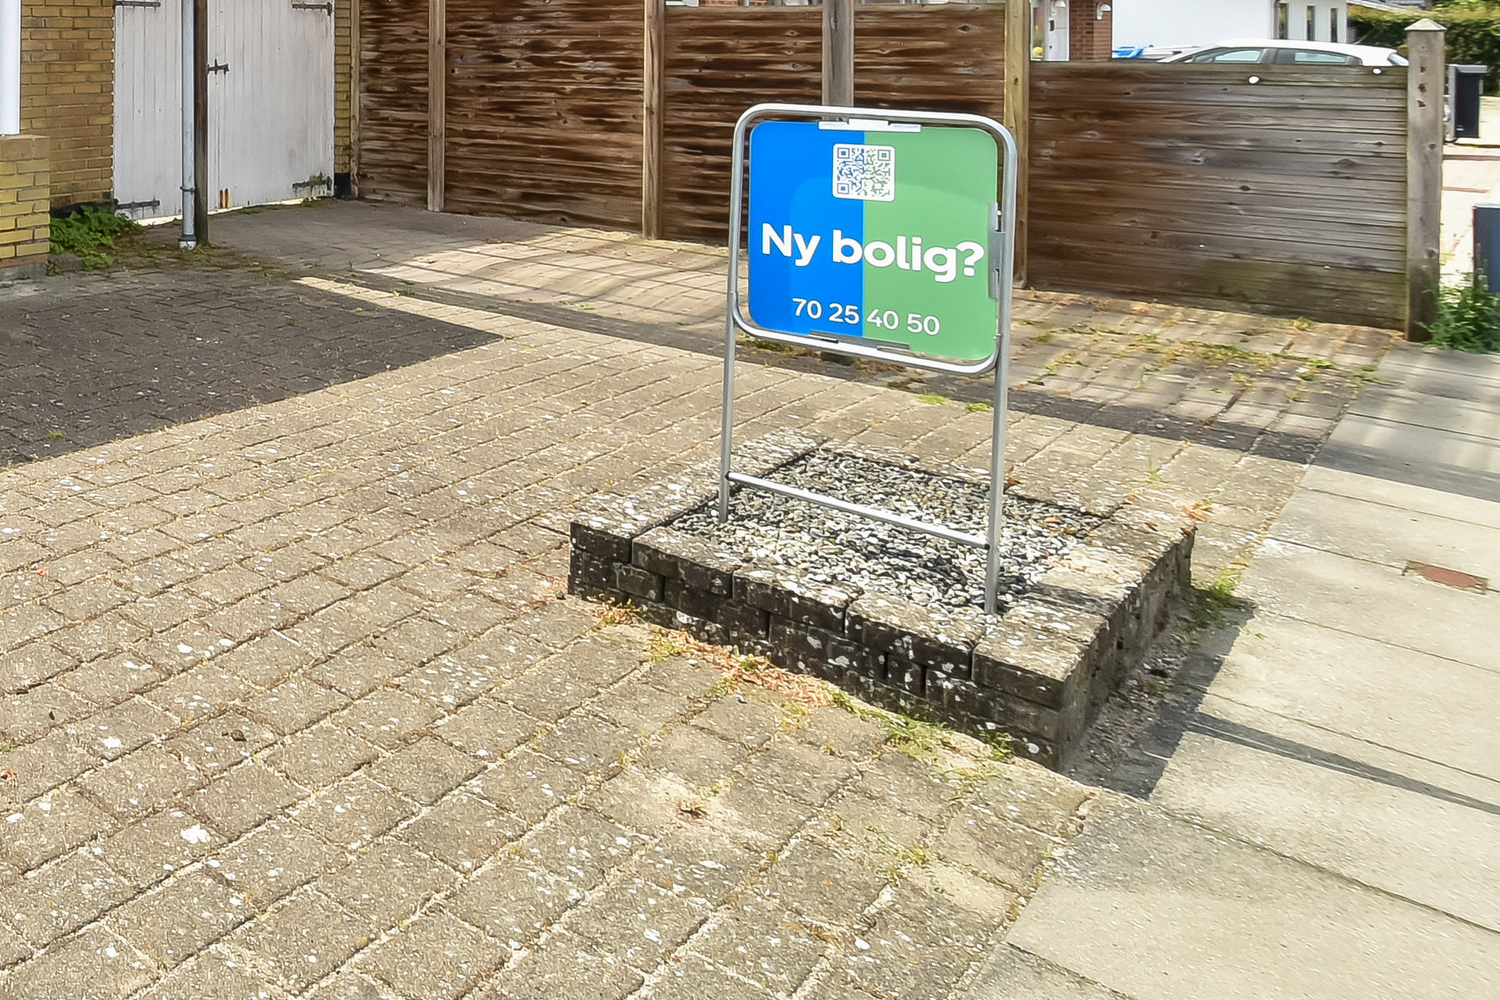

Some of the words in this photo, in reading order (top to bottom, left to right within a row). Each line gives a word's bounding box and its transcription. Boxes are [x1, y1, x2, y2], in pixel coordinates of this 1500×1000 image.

[762, 223, 821, 267] Ny
[832, 229, 984, 282] bolig?
[792, 298, 822, 319] 70
[829, 303, 859, 324] 25
[866, 308, 899, 330] 40
[906, 314, 940, 336] 50
